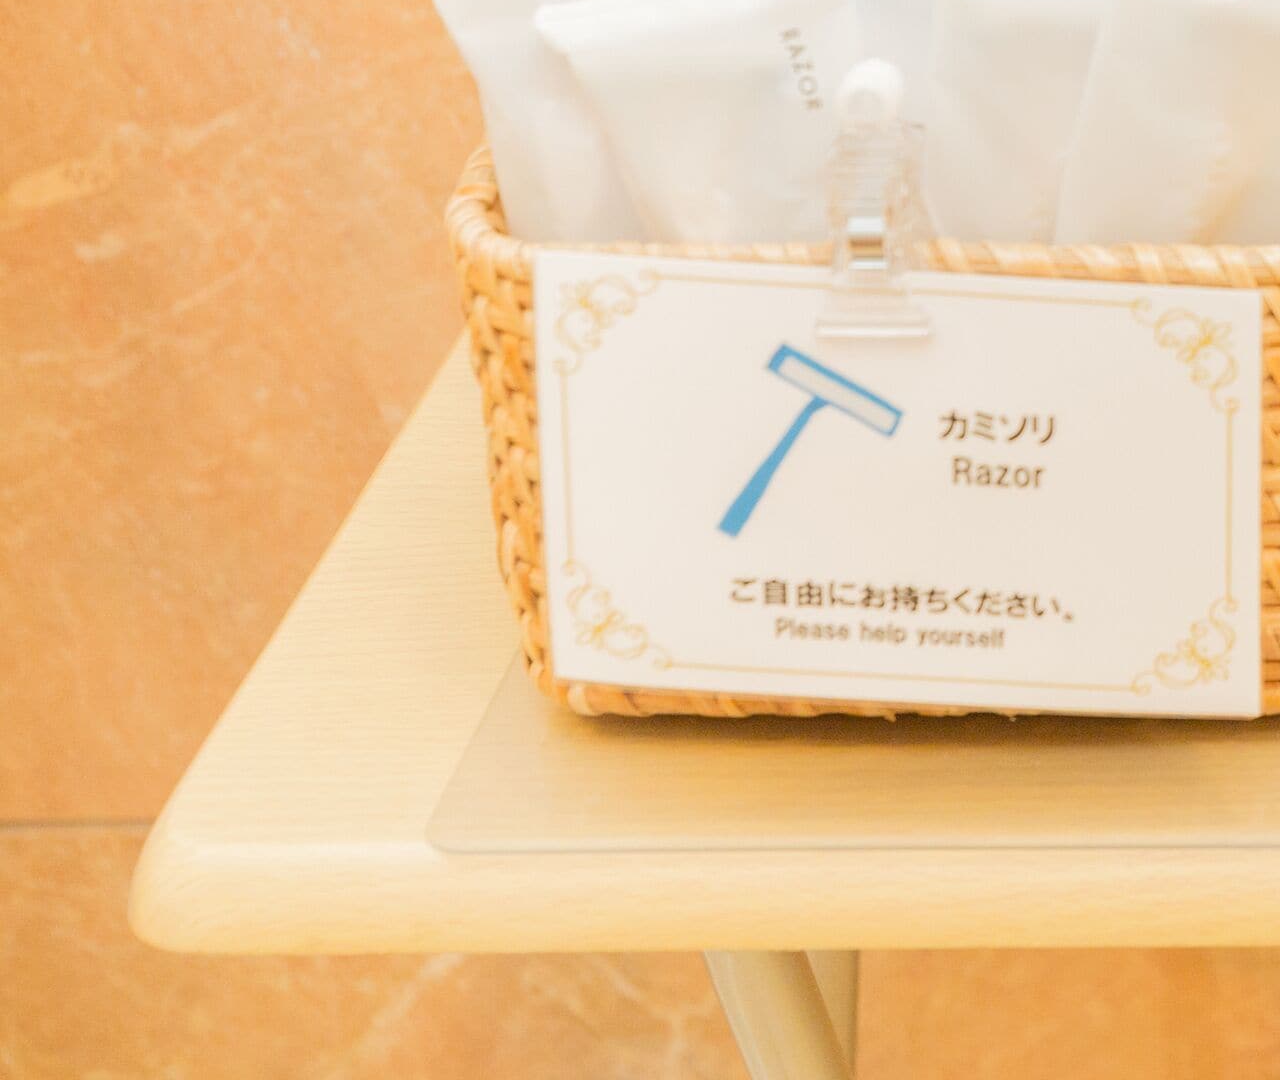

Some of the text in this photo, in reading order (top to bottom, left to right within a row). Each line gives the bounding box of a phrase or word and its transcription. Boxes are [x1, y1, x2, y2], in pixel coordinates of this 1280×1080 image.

[941, 411, 1054, 444] カミソリ
[953, 457, 1044, 488] Razor
[731, 578, 1073, 622] ご自由にお持ちください。
[775, 618, 1006, 649] Please help yourself
